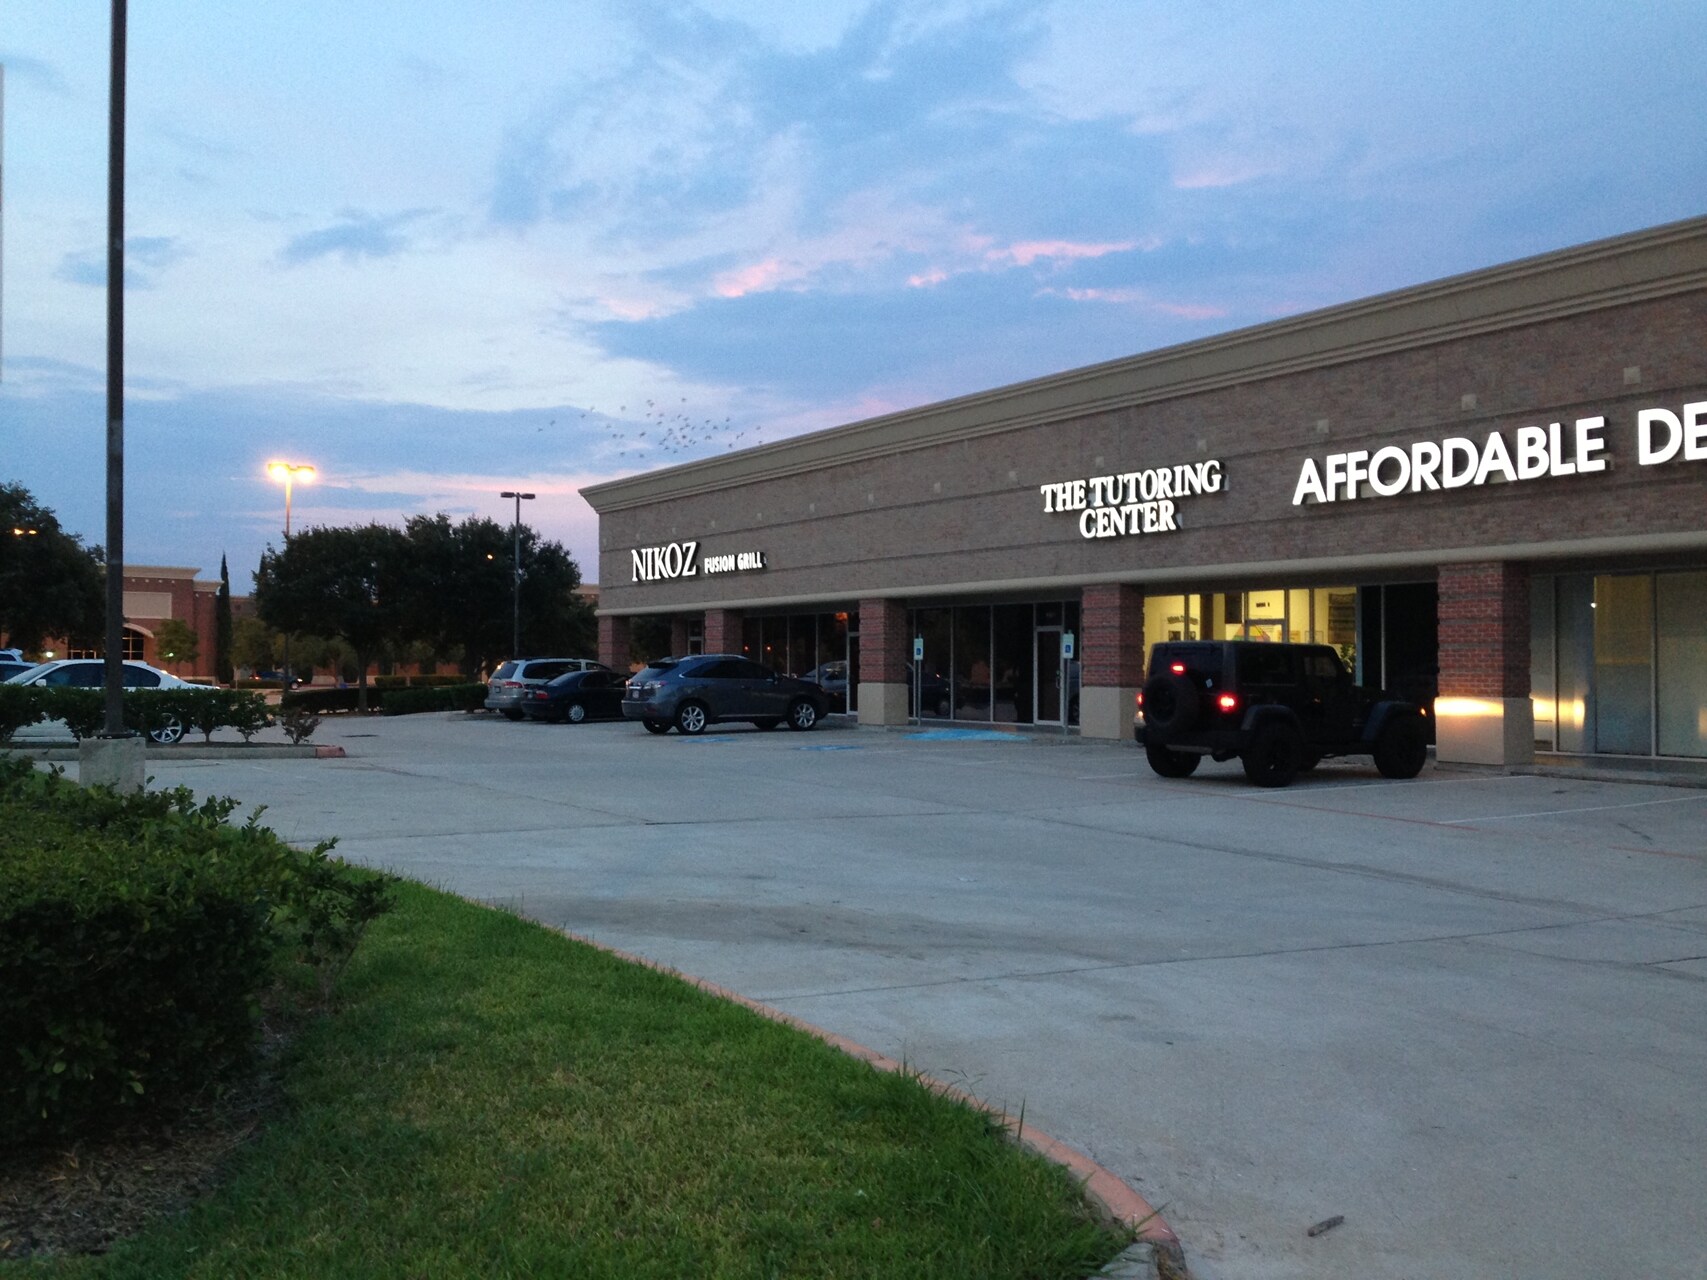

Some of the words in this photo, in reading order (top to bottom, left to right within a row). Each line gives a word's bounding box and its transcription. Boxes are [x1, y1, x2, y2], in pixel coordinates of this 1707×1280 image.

[1292, 415, 1606, 506] AFFORDABLE
[1637, 401, 1707, 466] DE
[1040, 479, 1087, 513] THE
[1089, 459, 1222, 508] TUTORING
[1079, 499, 1177, 539] CENTER
[631, 541, 697, 583] NIKOZ
[703, 554, 736, 574] FUSION
[737, 551, 763, 571] GRILL
